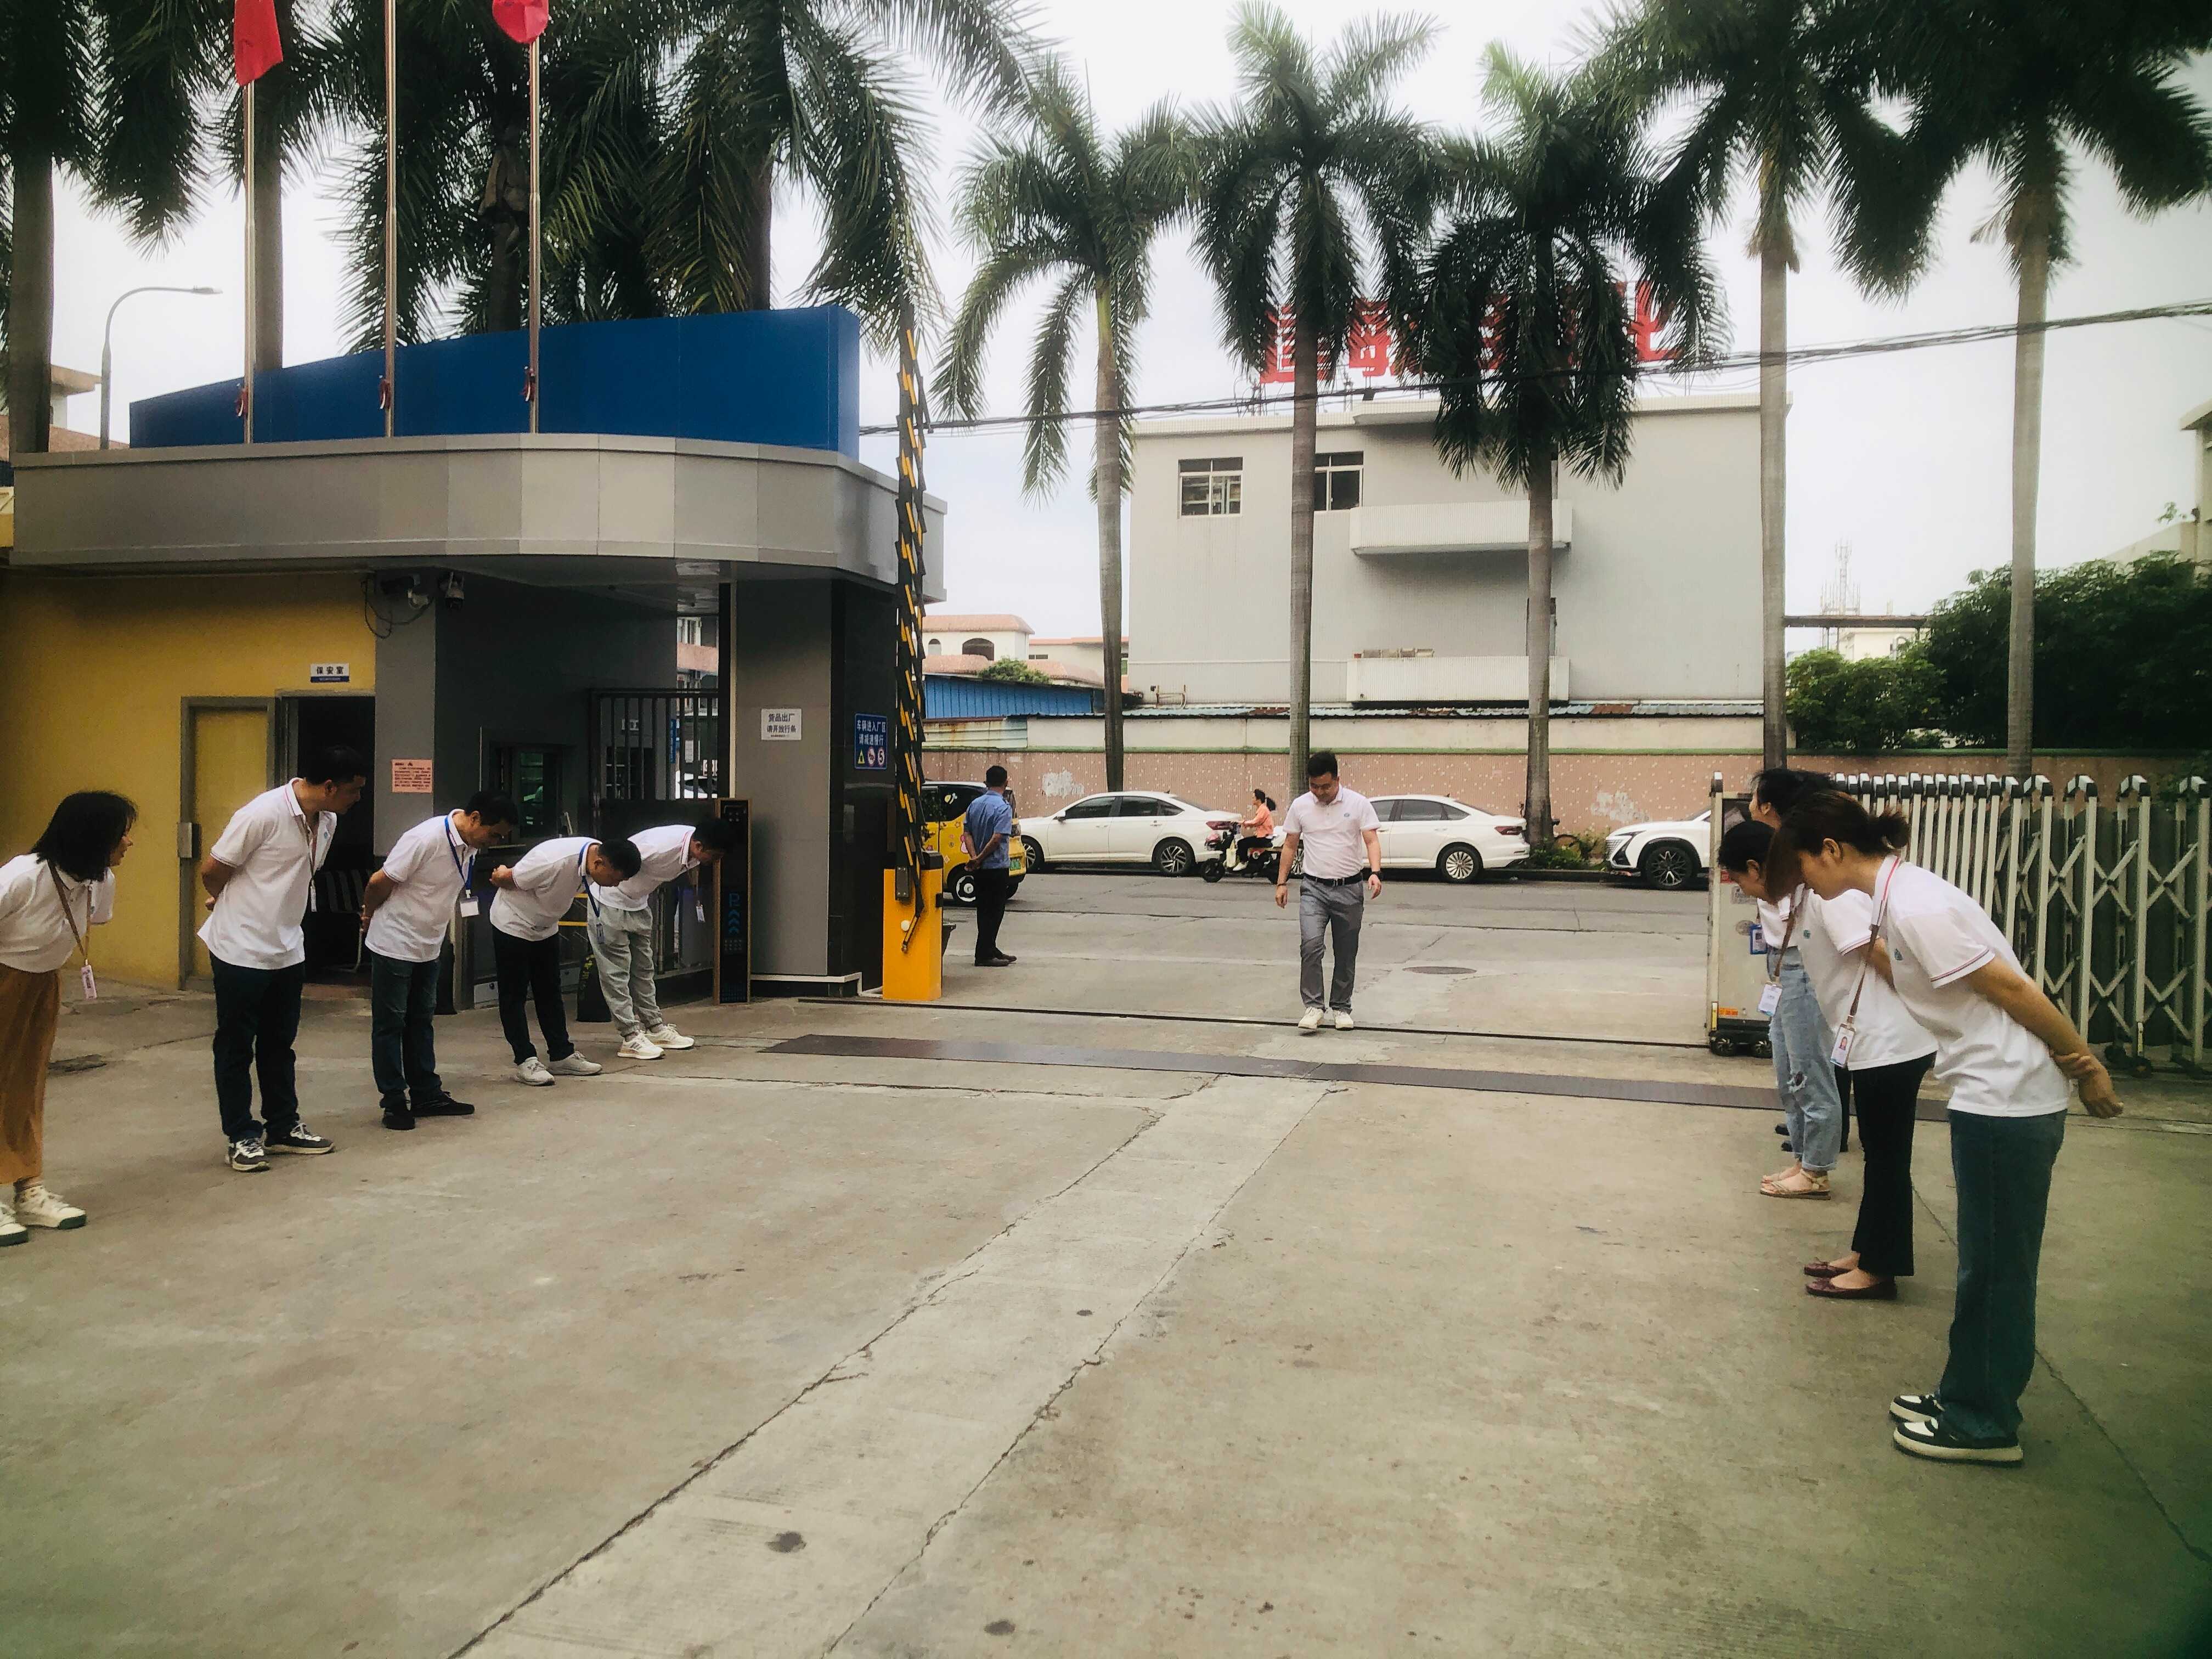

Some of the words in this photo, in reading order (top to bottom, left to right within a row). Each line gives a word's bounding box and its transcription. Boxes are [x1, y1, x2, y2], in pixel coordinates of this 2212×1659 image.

[317, 666, 344, 675] 保安室
[768, 713, 795, 722] 货品出厂
[857, 720, 885, 732] 车辆进入厂区
[859, 733, 884, 746] 请减速慢行
[879, 751, 883, 763] 5
